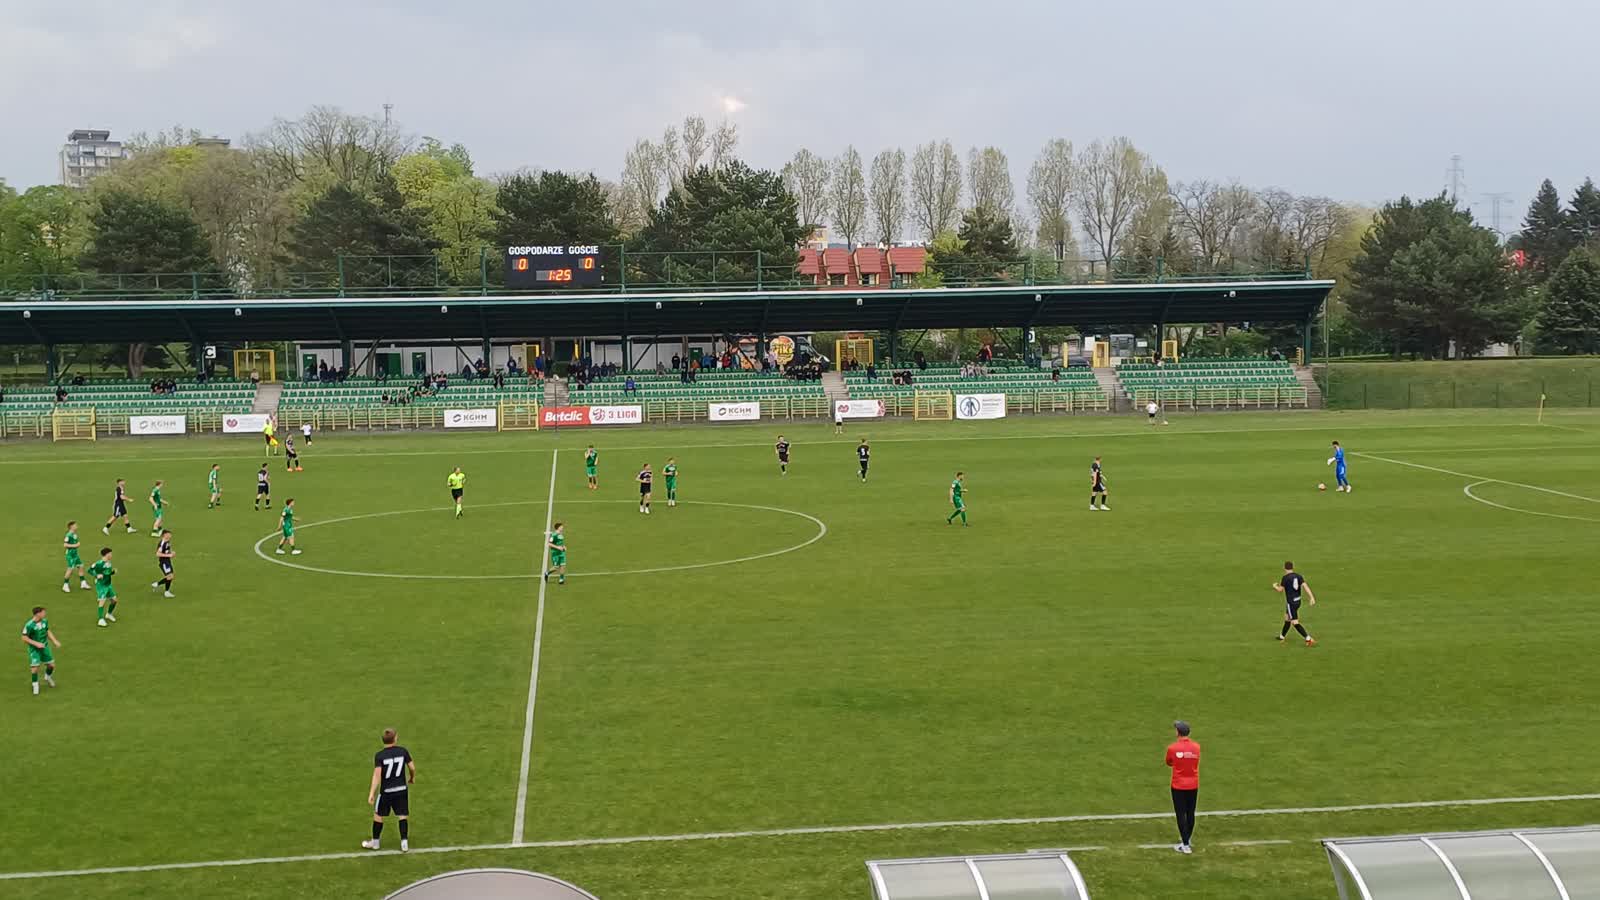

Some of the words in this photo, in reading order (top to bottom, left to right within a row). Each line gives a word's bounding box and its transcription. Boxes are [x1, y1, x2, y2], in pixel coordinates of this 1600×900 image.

[508, 245, 564, 255] GOSPODARZE
[568, 244, 599, 255] GOŚCIE
[518, 258, 527, 270] 0
[584, 257, 593, 269] 0
[548, 269, 572, 281] 1:25
[205, 347, 214, 357] C
[545, 410, 583, 422] Betclic
[608, 411, 614, 419] 3
[617, 410, 637, 419] LIGA
[383, 756, 405, 779] 77
